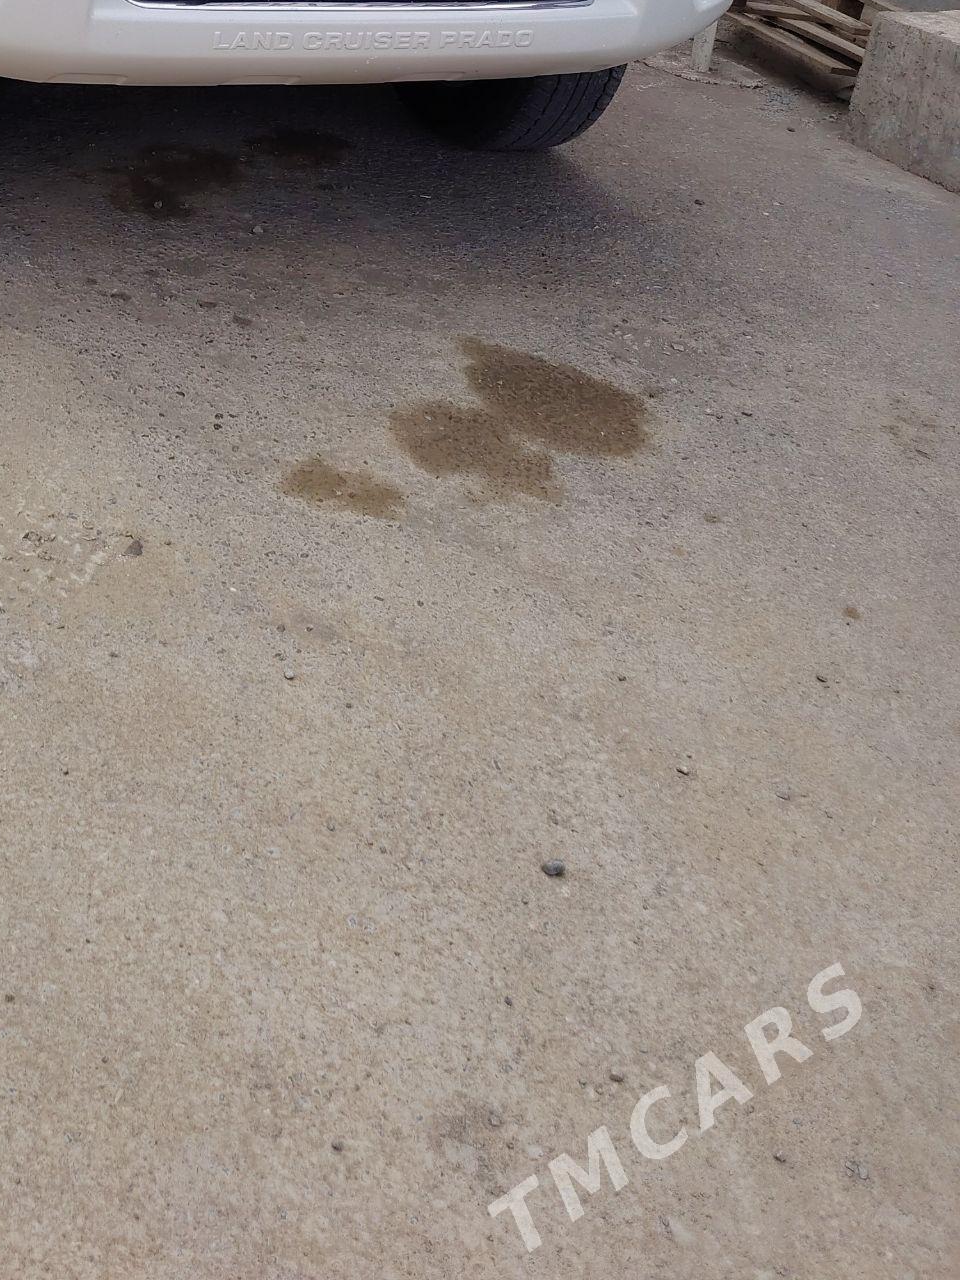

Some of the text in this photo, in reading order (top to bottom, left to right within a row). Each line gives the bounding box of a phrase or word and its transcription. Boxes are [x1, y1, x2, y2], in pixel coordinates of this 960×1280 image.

[212, 29, 535, 51] LAND CRUISER PRADO
